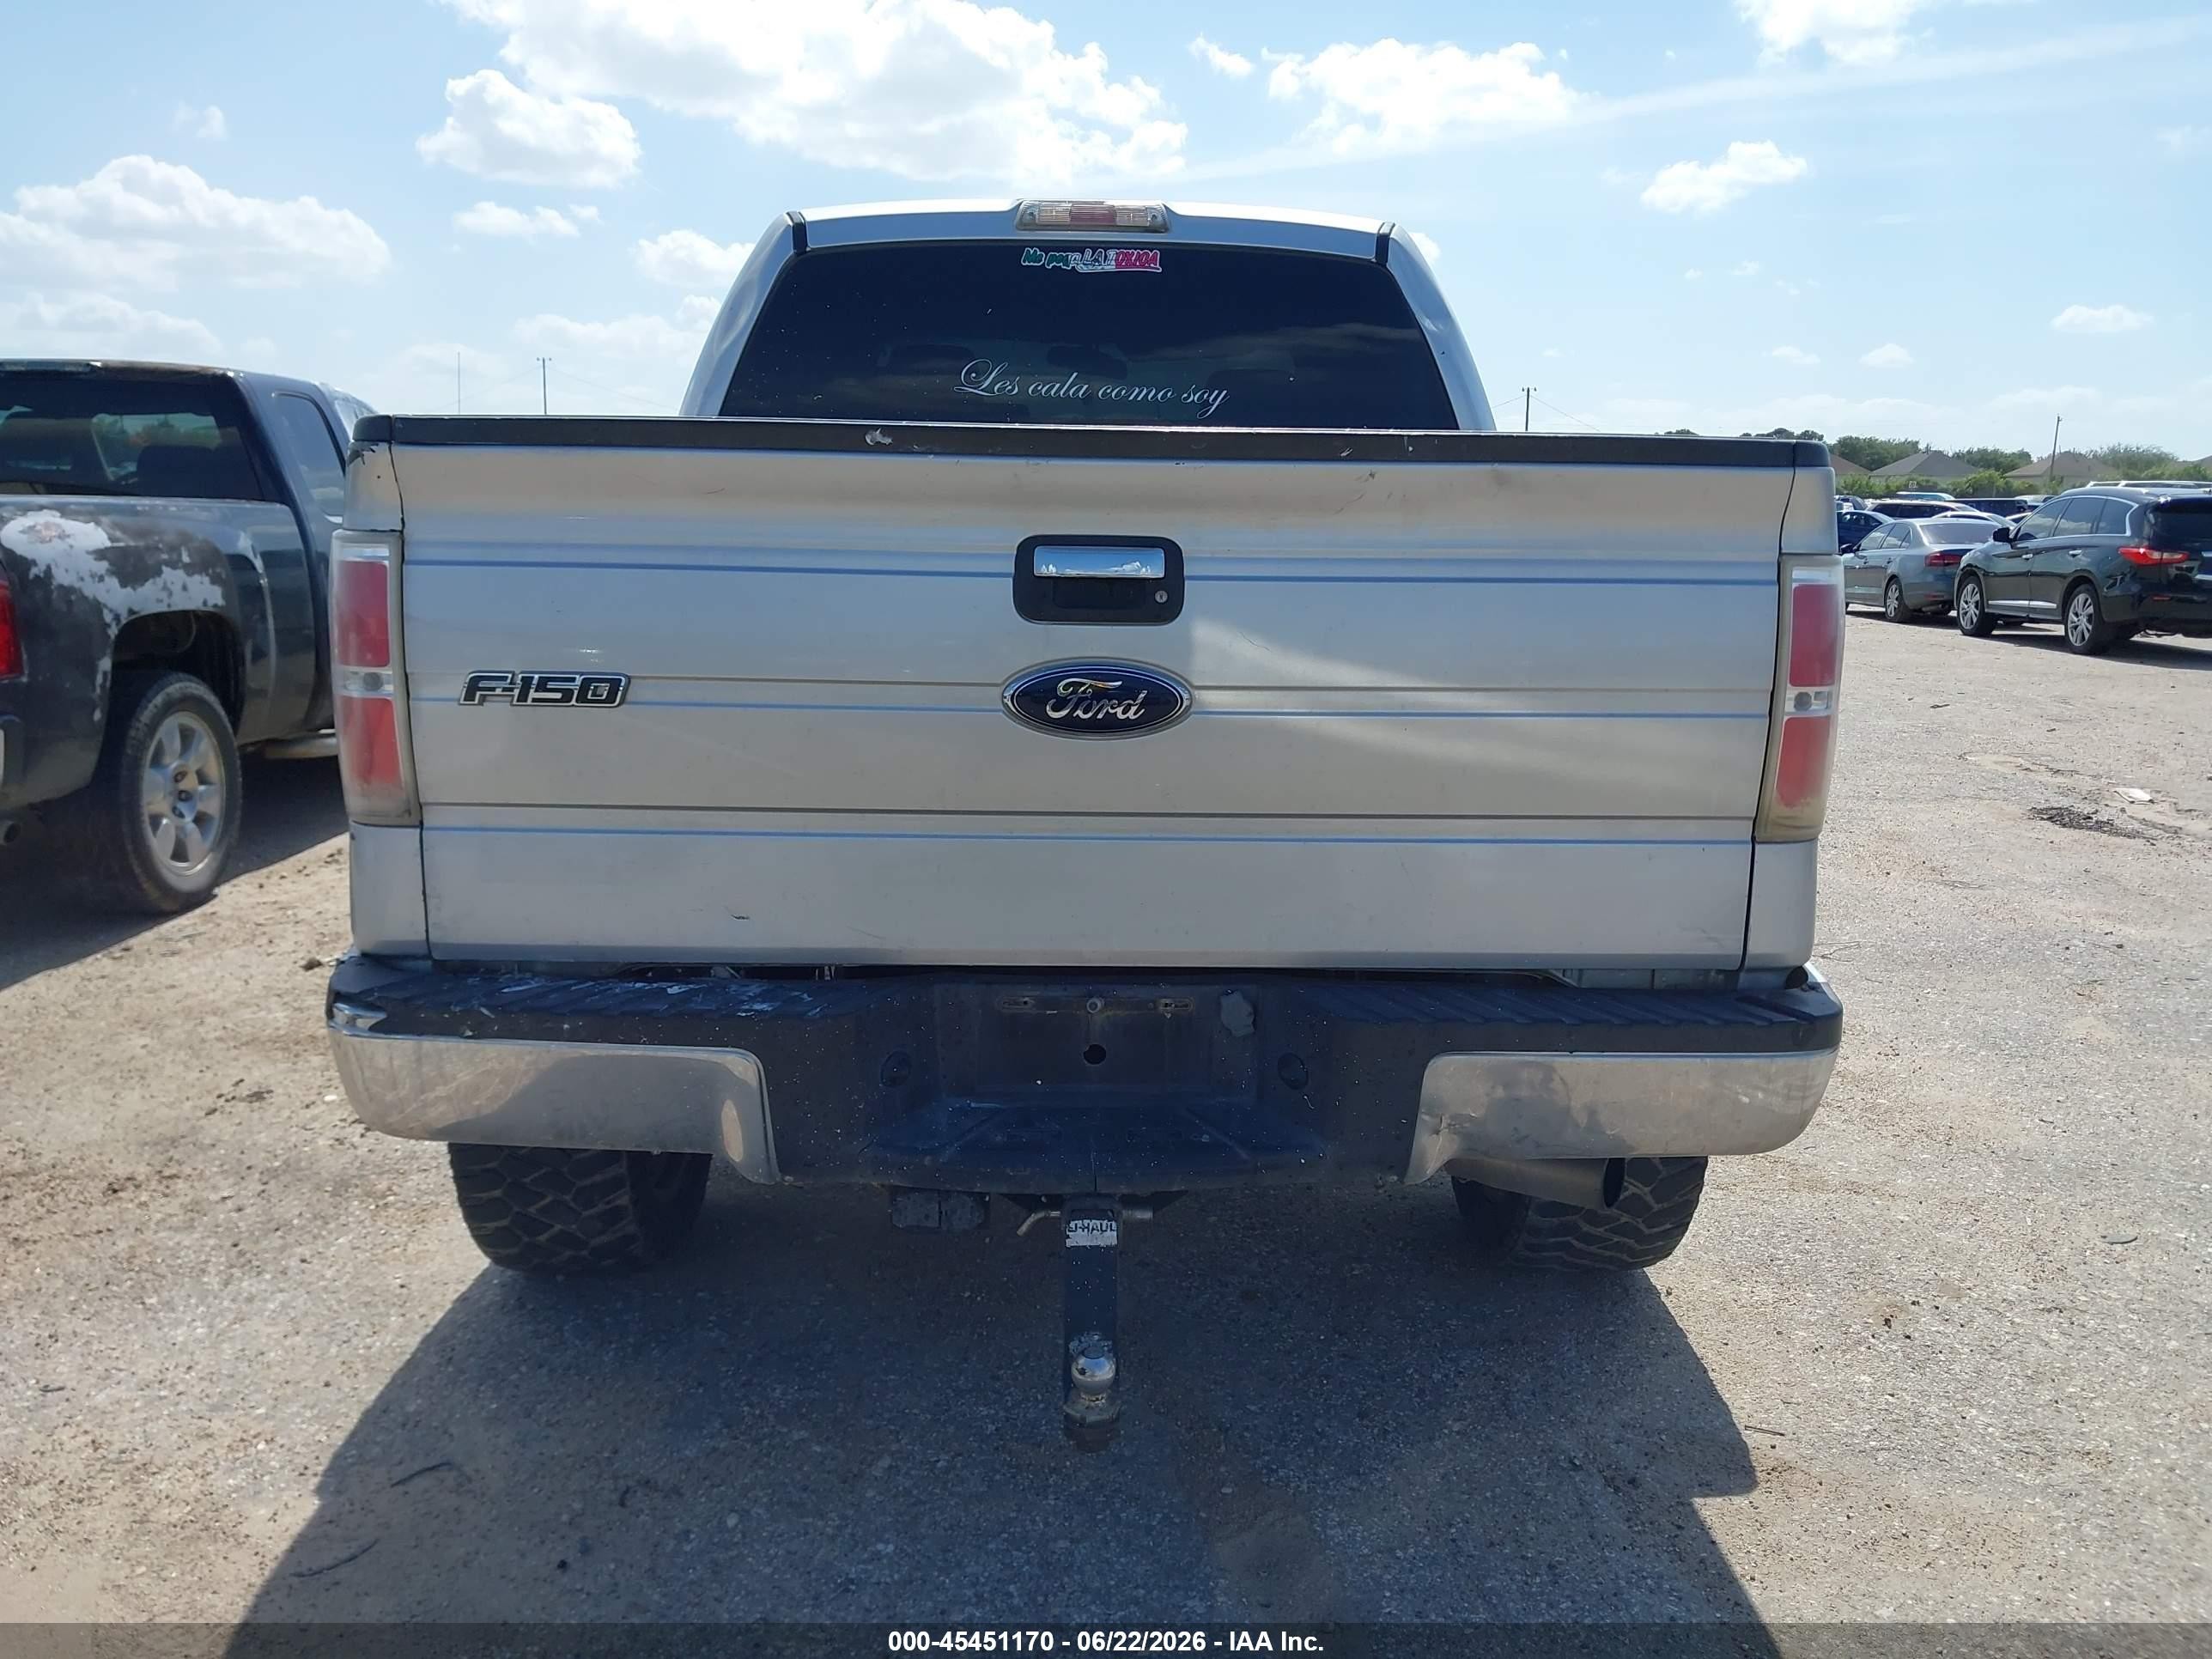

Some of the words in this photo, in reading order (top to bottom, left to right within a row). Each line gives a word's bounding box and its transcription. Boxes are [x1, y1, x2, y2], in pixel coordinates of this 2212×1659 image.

[1080, 248, 1104, 267] LA
[953, 359, 1020, 397] Les
[1028, 372, 1091, 399] cala
[1097, 385, 1176, 402] como
[1181, 383, 1230, 419] soy
[458, 670, 631, 708] F-150
[1046, 678, 1148, 720] Ford
